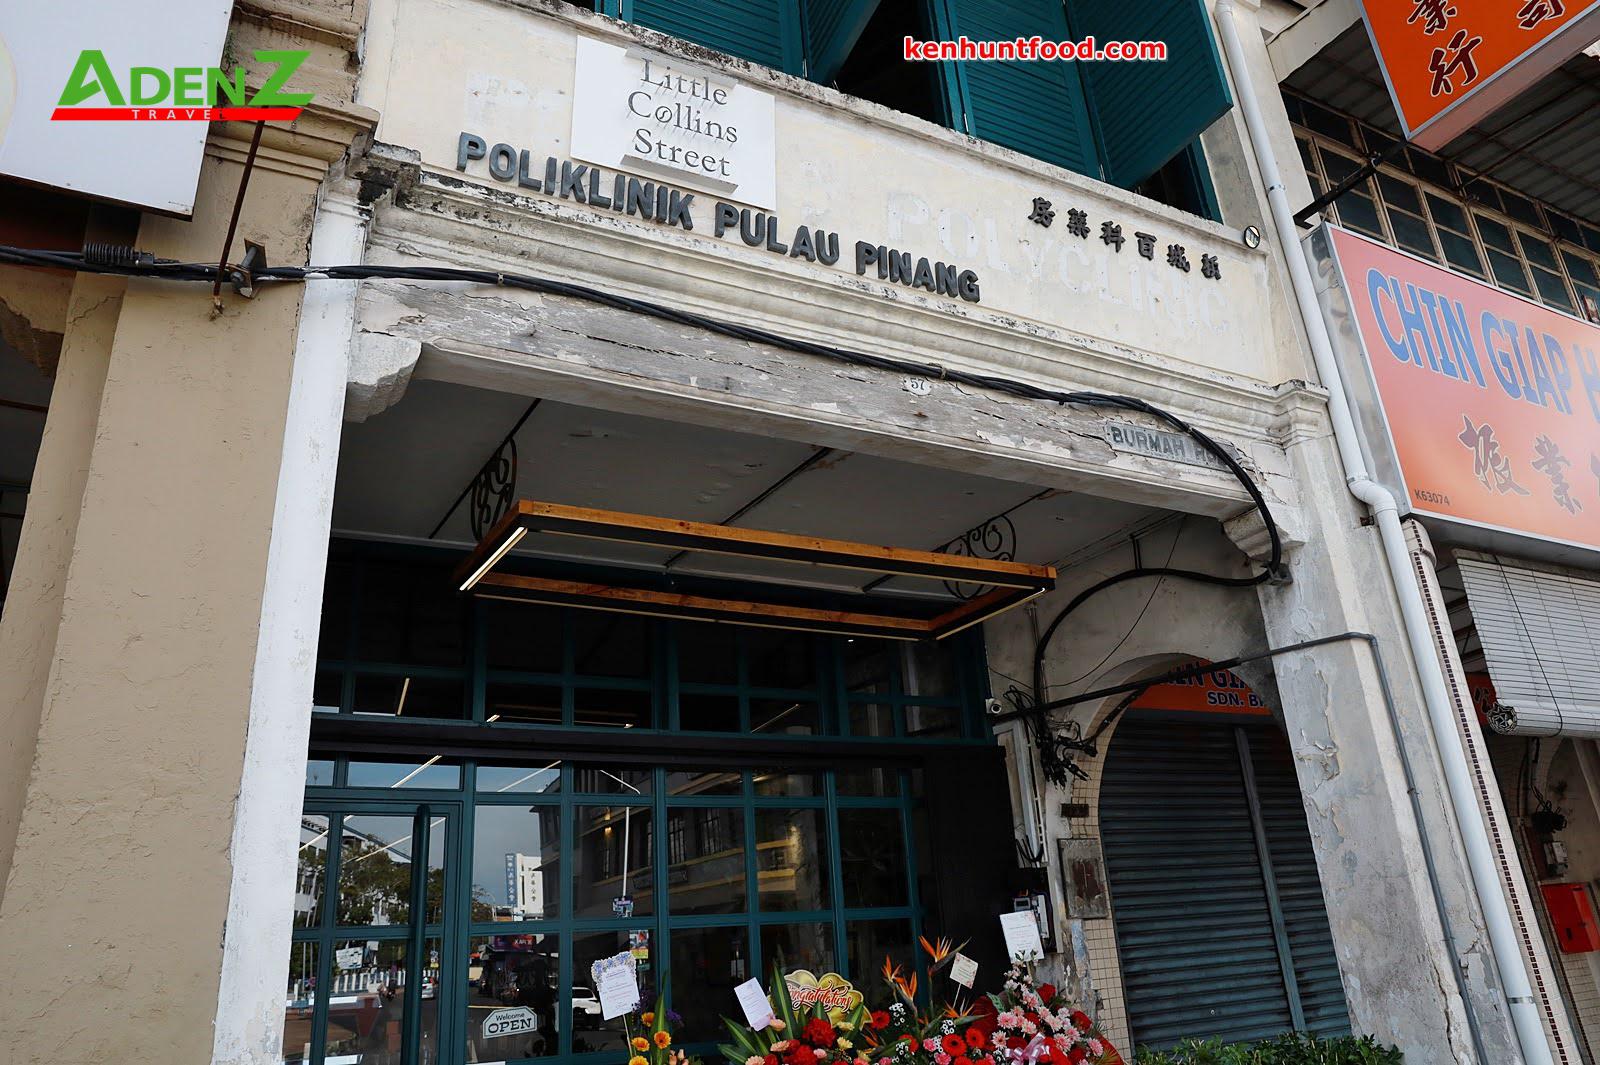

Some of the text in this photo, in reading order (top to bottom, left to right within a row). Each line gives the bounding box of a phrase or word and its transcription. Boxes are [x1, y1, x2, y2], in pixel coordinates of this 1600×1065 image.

[640, 57, 728, 106] Little
[627, 90, 738, 143] Collins
[634, 127, 731, 177] Street
[456, 131, 981, 303] POLIKLINIK PULAU PINANG
[1367, 268, 1487, 388] CHIN
[1481, 310, 1573, 415] GIAP
[910, 377, 925, 391] 57
[1110, 426, 1186, 456] BURMAH
[1414, 489, 1451, 506] K63074
[1207, 691, 1265, 708] SDN. B
[487, 1017, 533, 1034] OPEN
[495, 1012, 526, 1022] Welcome
